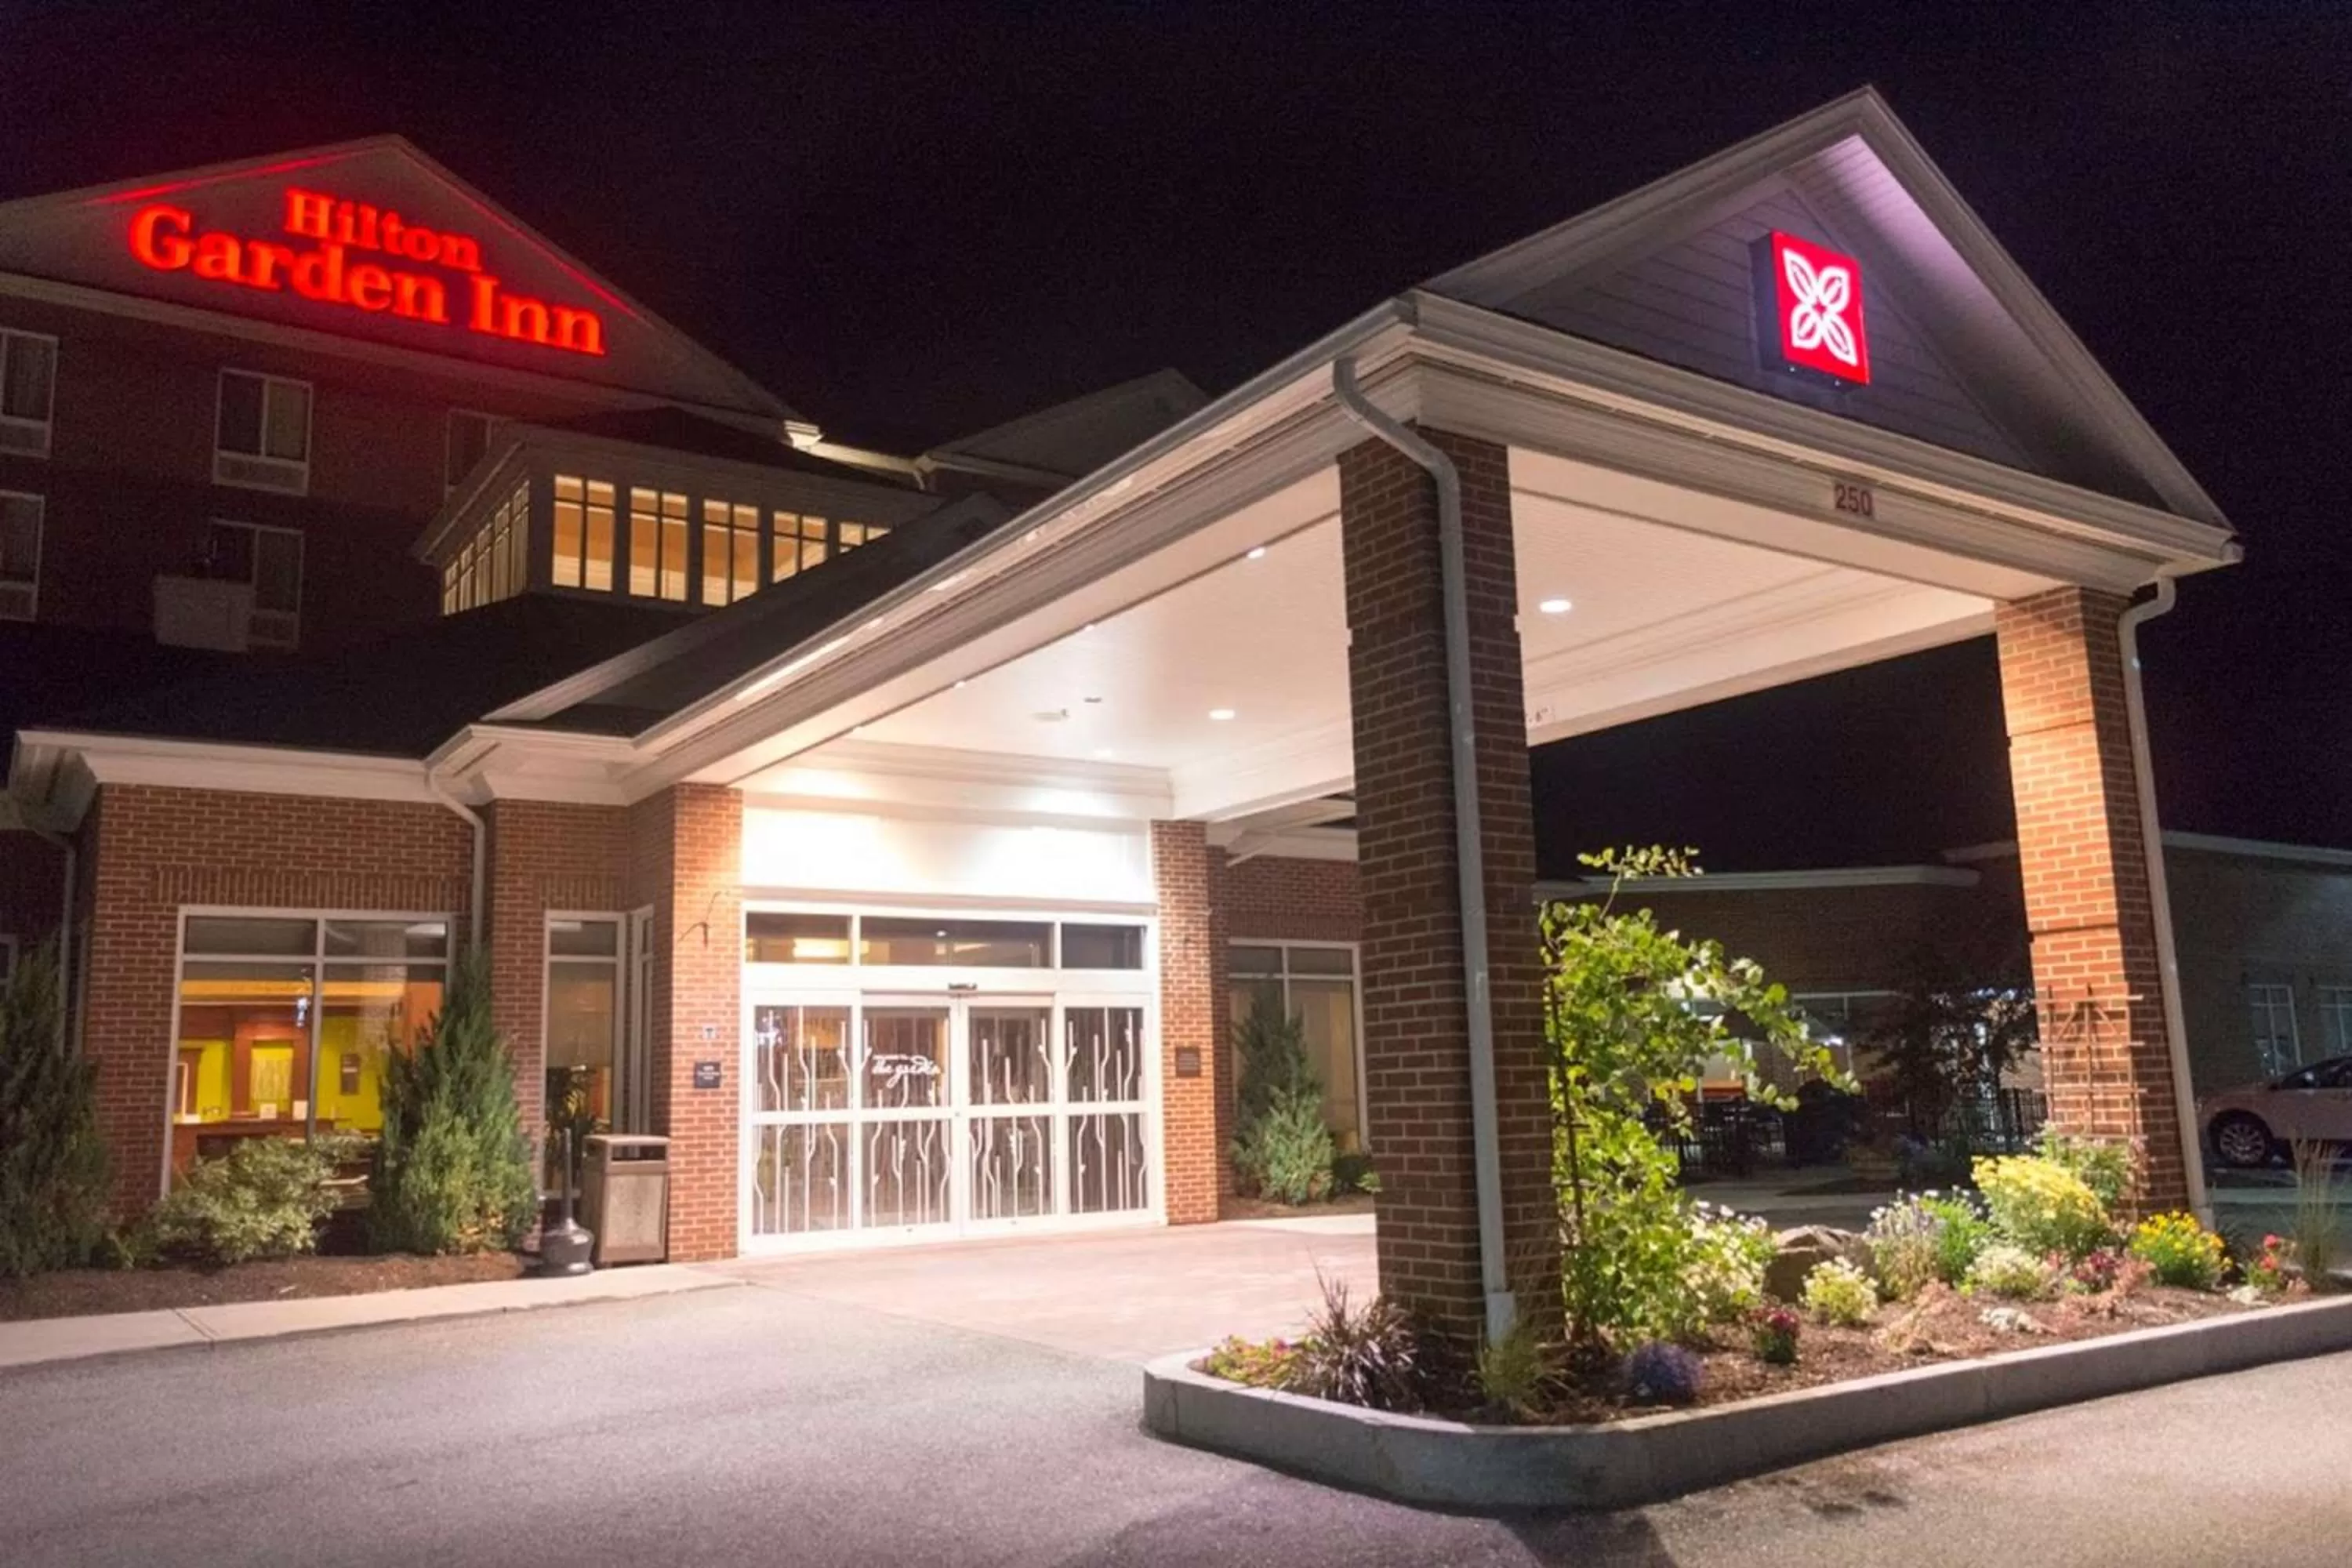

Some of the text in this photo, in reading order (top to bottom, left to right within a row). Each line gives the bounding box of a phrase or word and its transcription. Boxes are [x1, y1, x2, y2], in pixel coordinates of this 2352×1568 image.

[285, 189, 482, 271] Hilton
[130, 206, 606, 356] Garden Inn
[1833, 483, 1874, 517] 250
